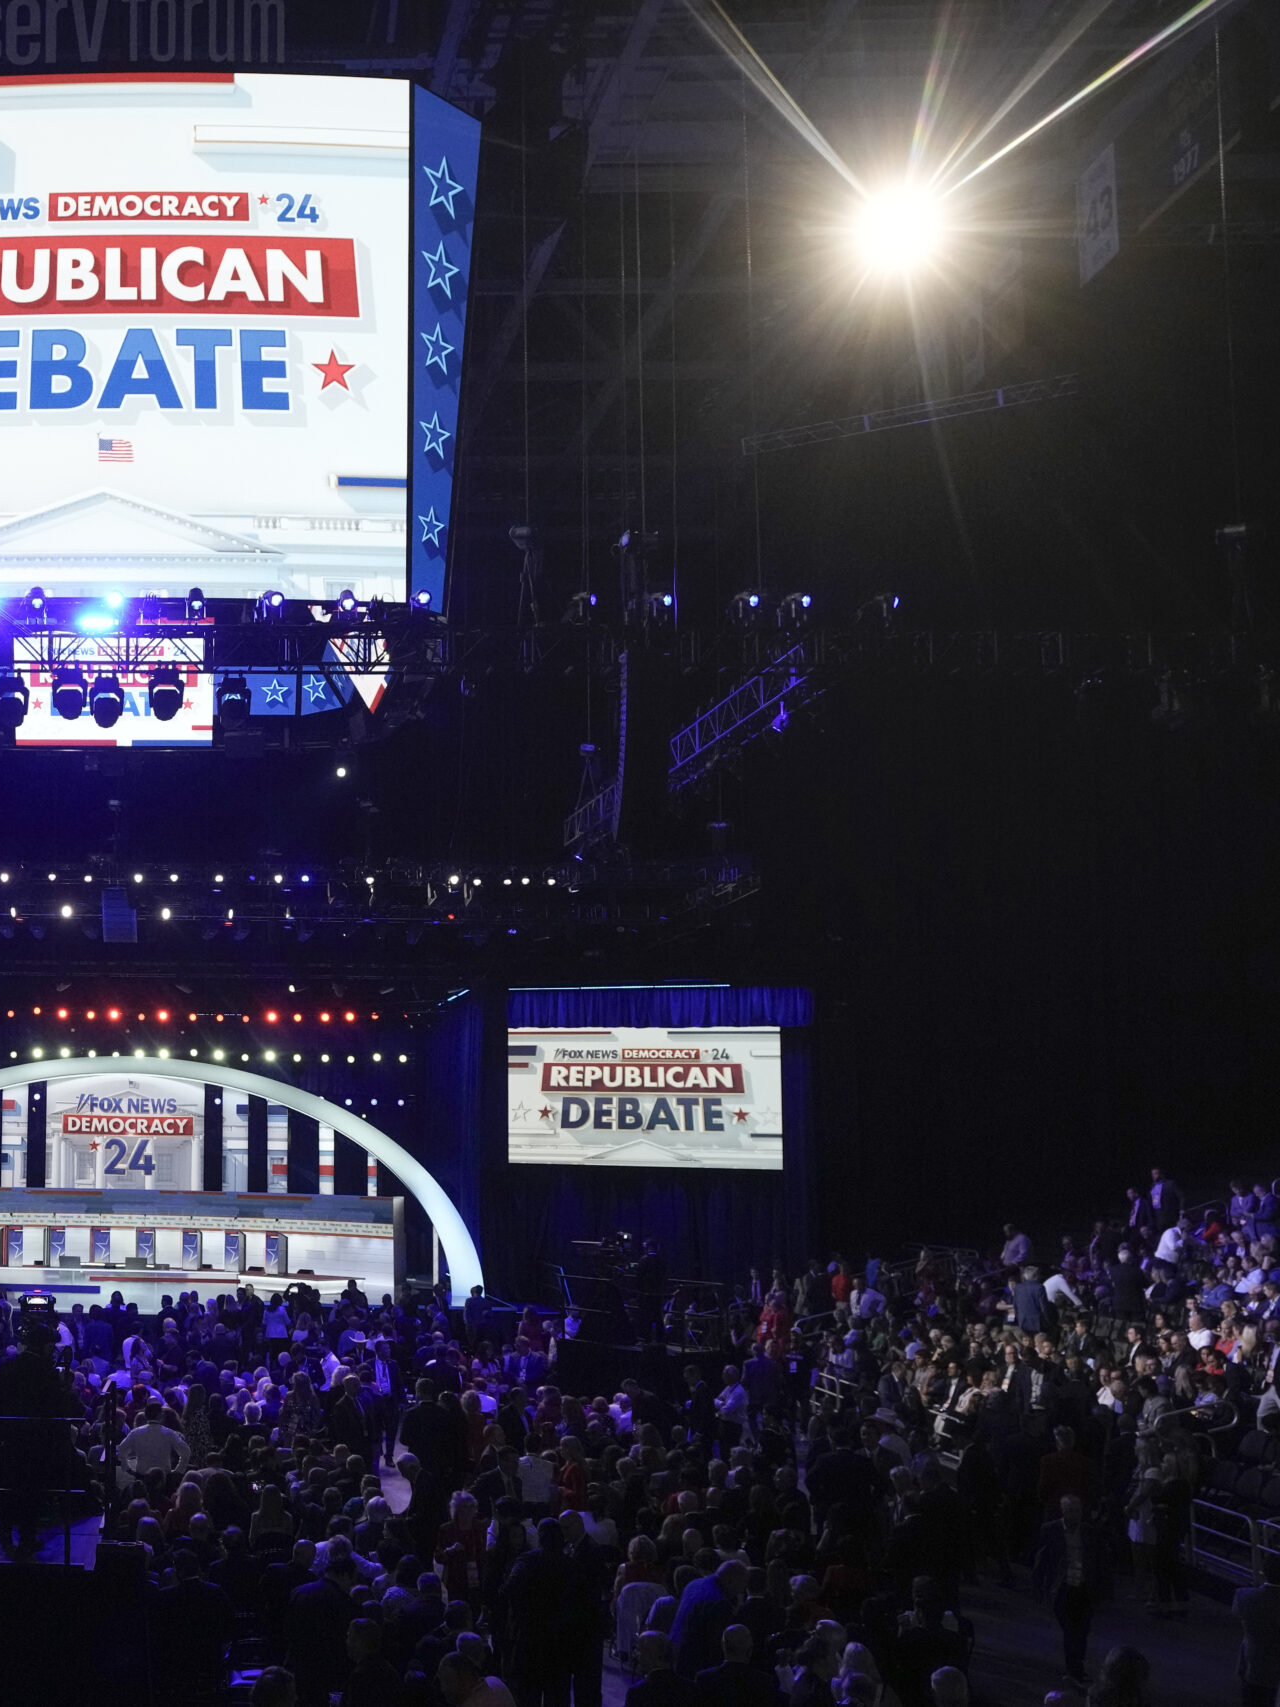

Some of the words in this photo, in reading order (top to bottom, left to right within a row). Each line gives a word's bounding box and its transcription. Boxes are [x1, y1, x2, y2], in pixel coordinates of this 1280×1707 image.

[122, 0, 285, 64] forum
[56, 195, 241, 218] DEMOCRACY
[276, 193, 320, 223] 24
[562, 1050, 584, 1059] FOX
[586, 1050, 618, 1059] NEWS
[624, 1049, 698, 1059] DEMOCRACY
[712, 1048, 730, 1060] 24
[550, 1066, 734, 1088] REPUBLICAN
[89, 1098, 125, 1113] FOX
[127, 1098, 177, 1113] NEWS
[560, 1096, 725, 1131] DEBATE
[67, 1117, 189, 1133] DEMOCRACY
[104, 1138, 156, 1176] 24
